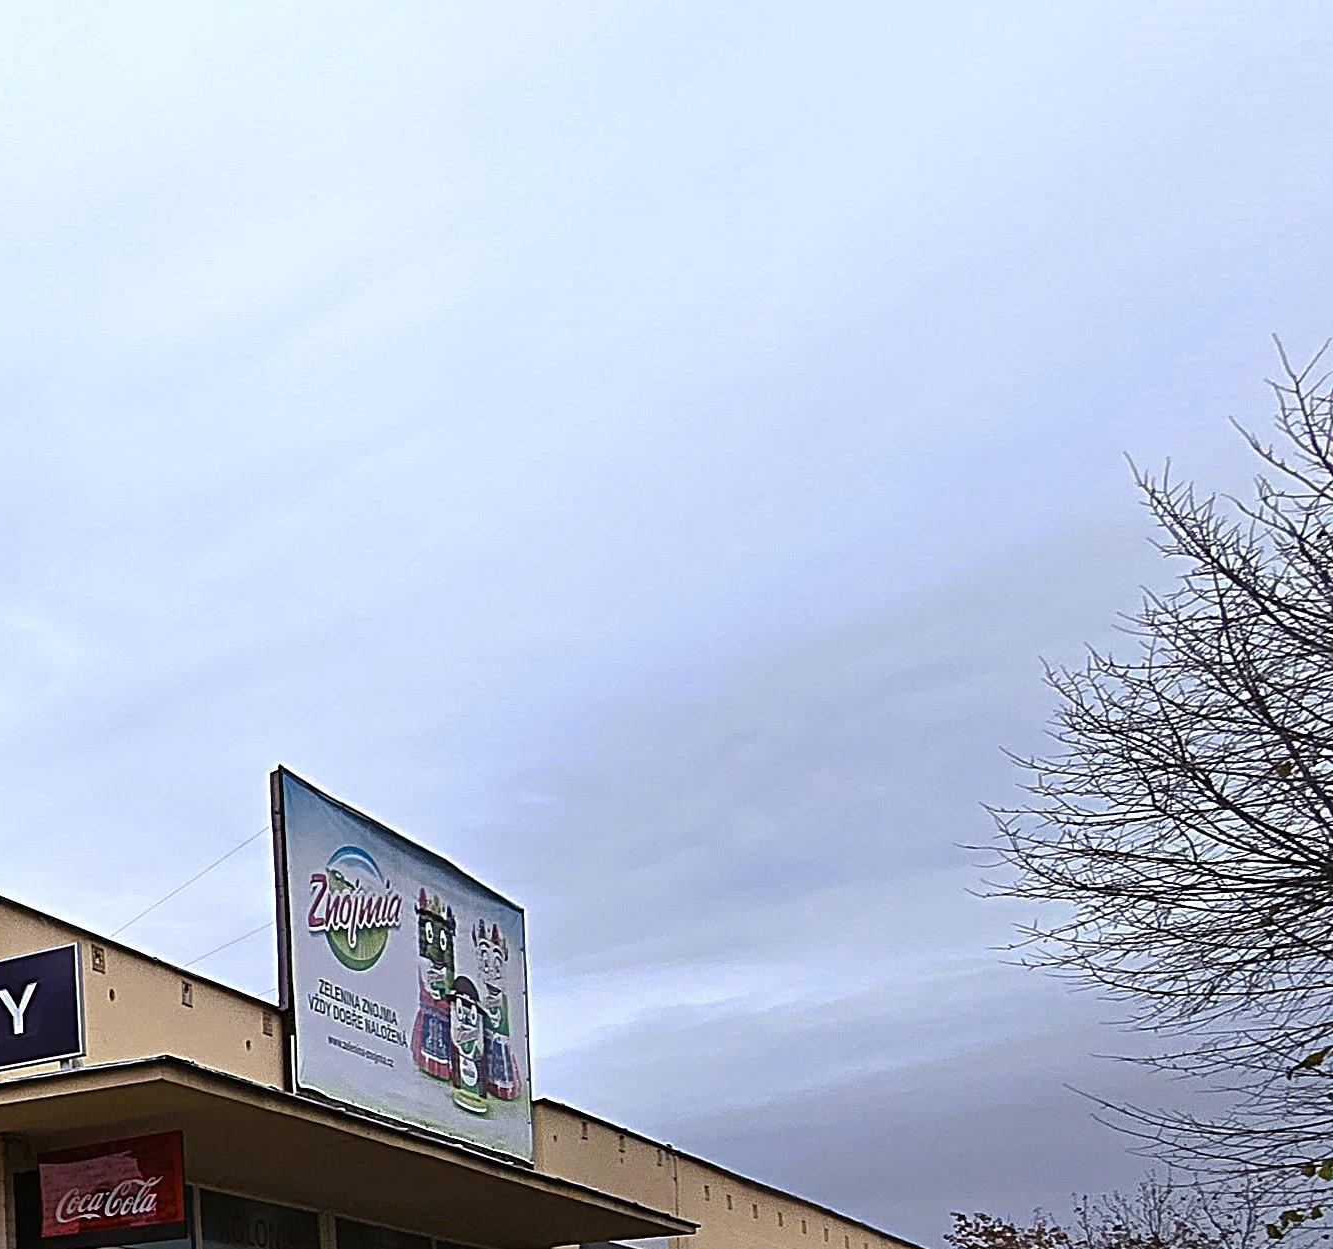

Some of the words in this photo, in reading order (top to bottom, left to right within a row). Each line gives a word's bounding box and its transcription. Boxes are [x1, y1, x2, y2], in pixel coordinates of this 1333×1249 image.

[308, 873, 402, 949] Znojmia
[308, 992, 331, 1019] VŽDY
[332, 1002, 363, 1031] DOBŘE
[364, 1016, 408, 1049] NALOŽENÁ
[318, 978, 361, 1011] ZELENINA
[361, 997, 398, 1026] ZNOJMIA
